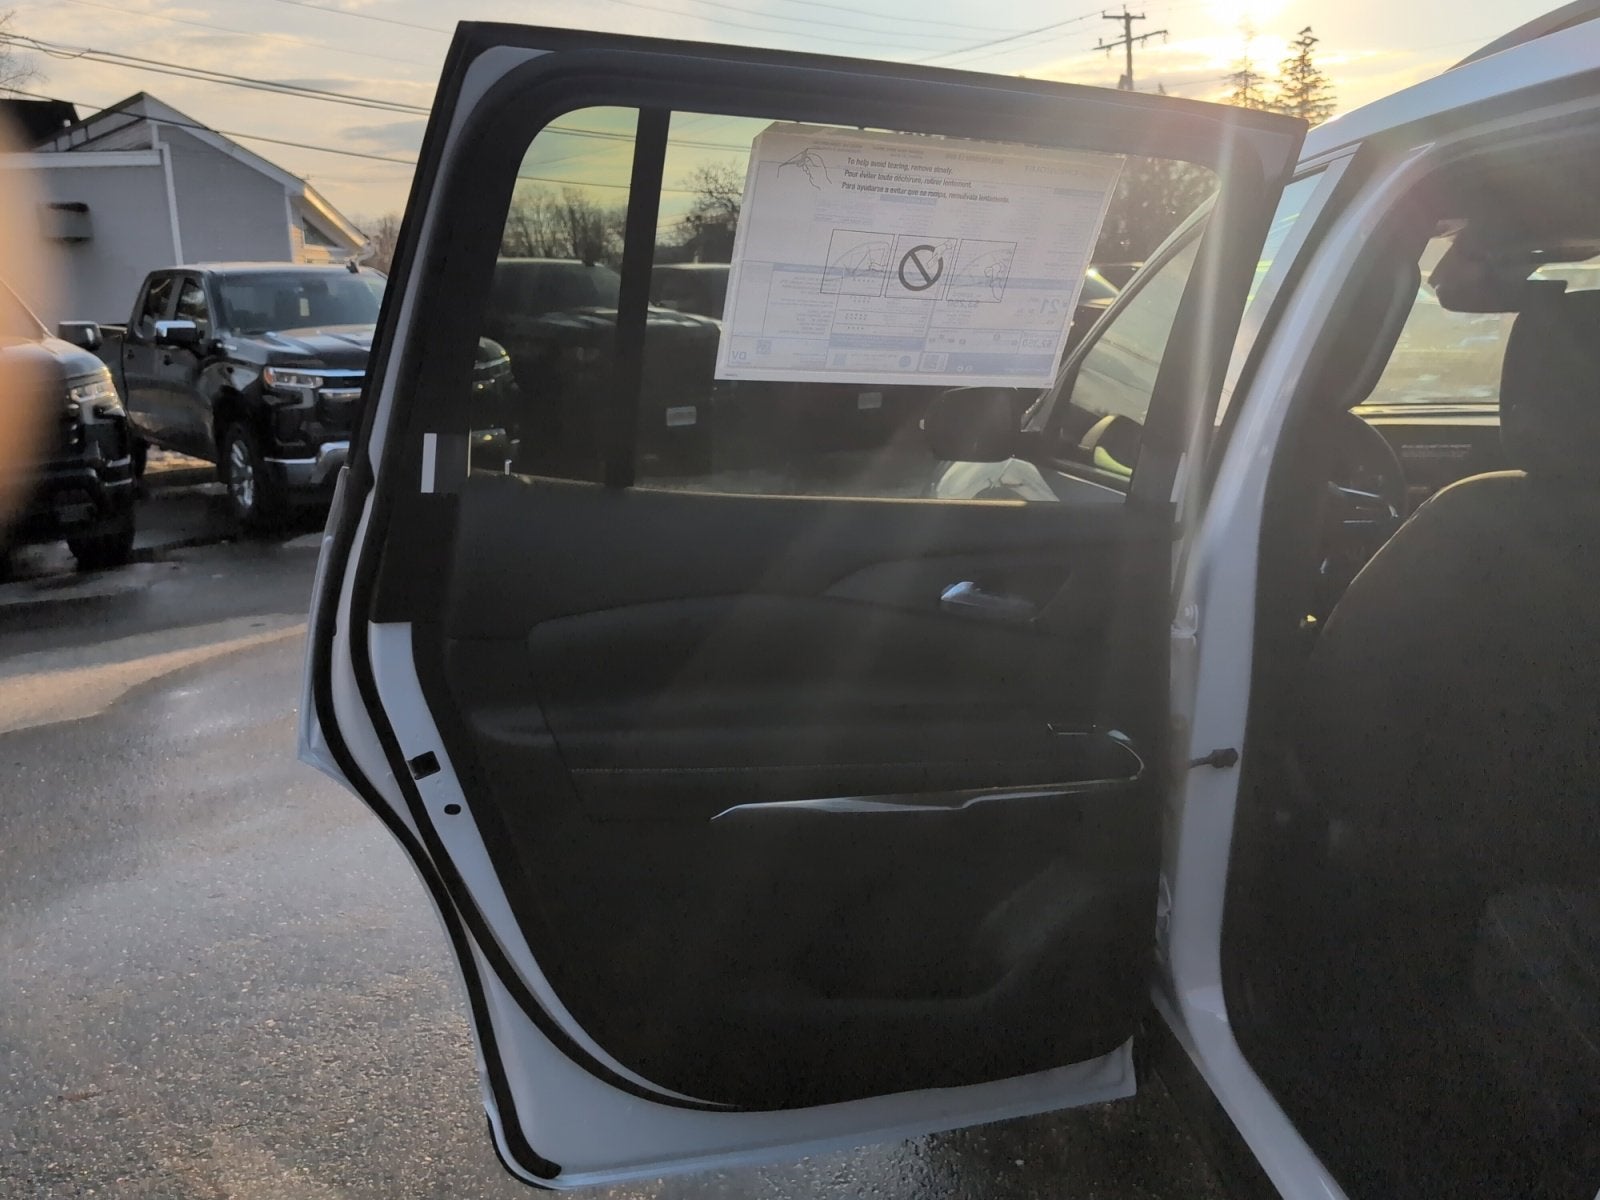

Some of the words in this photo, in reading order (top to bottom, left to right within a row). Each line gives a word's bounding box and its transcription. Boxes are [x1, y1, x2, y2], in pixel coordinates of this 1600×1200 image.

[856, 158, 869, 168] help
[870, 160, 887, 168] avoid
[844, 169, 858, 177] Pour
[878, 173, 893, 181] toute
[841, 181, 856, 190] Para
